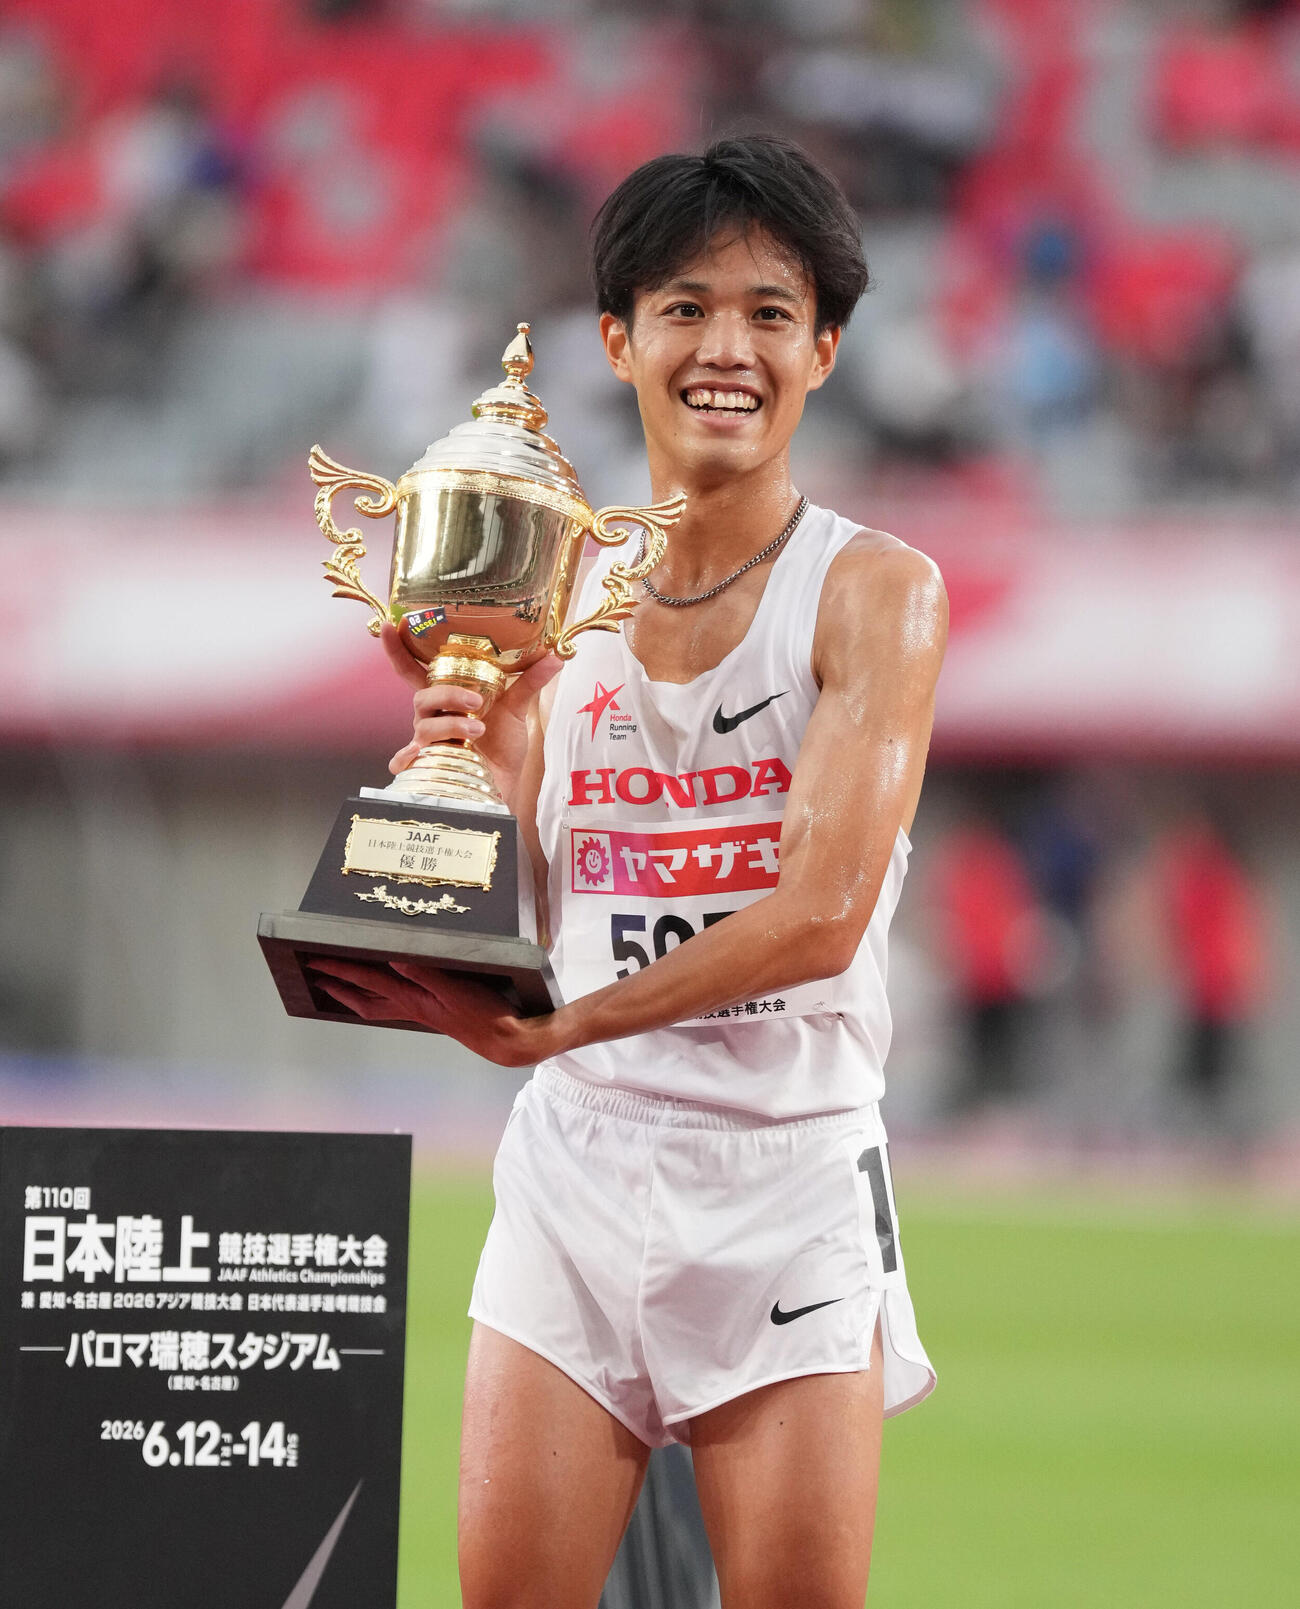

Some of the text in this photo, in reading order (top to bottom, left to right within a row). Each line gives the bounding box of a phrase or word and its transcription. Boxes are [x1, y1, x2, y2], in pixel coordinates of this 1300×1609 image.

[609, 724, 637, 732] Running
[568, 757, 793, 808] HONDA
[368, 839, 473, 859] 日本陸上競技選手権大会
[406, 831, 440, 843] JAAF
[619, 837, 781, 884] ヤマザキ
[611, 910, 738, 980] 50
[24, 1185, 91, 1210] 第110回
[23, 1213, 388, 1283] 日本陸上 競技選手権大会
[217, 1267, 387, 1288] JAAF Athletics Championships
[65, 1329, 341, 1371] パロマ瑞穂スタジアム
[100, 1419, 146, 1440] 2026
